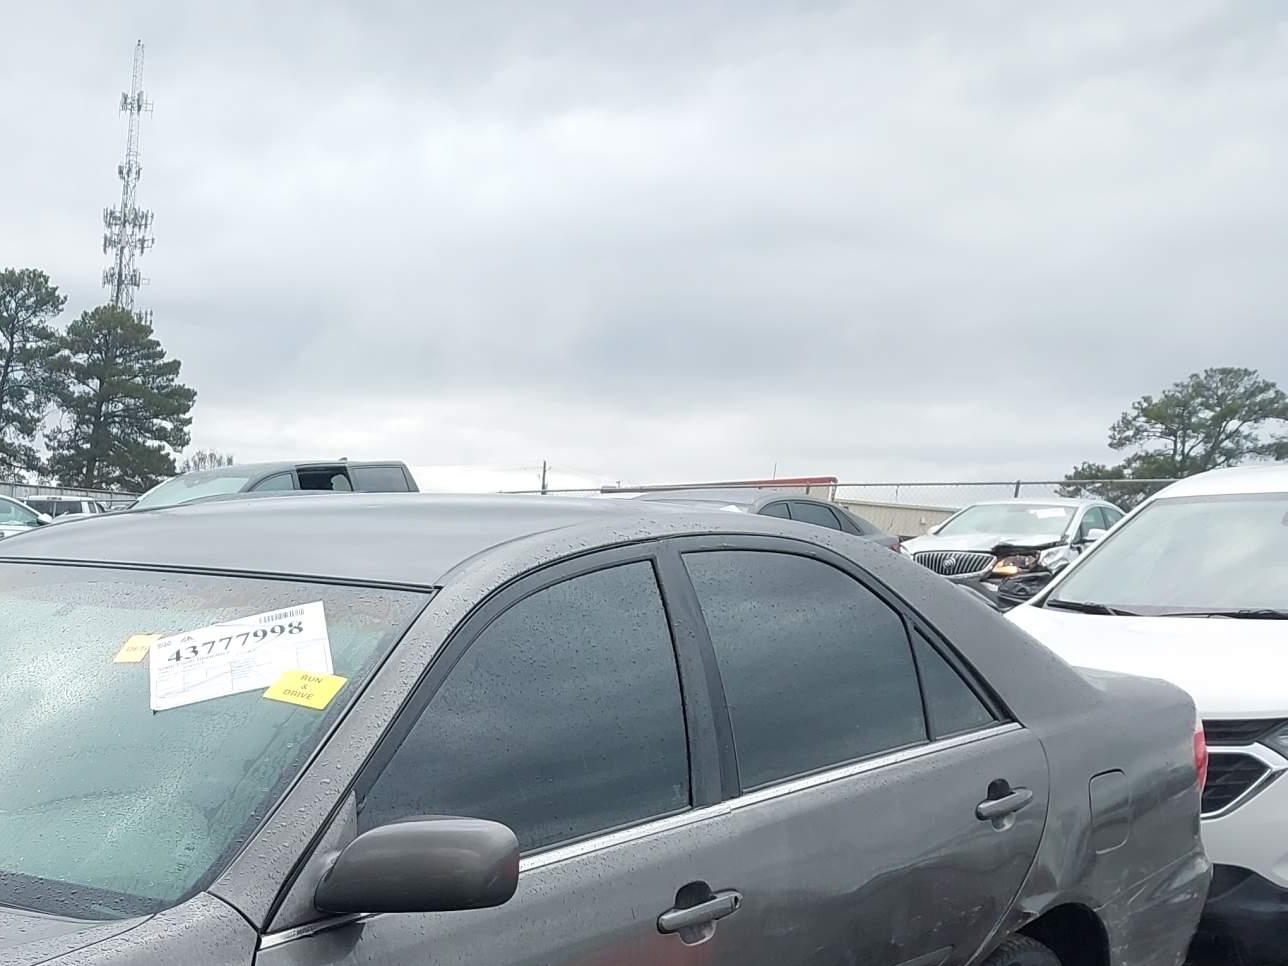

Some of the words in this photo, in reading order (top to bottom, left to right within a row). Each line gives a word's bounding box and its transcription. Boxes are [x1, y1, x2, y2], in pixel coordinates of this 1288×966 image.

[167, 620, 304, 663] 43777998
[300, 673, 324, 684] RUN
[282, 688, 314, 701] DRIVE
